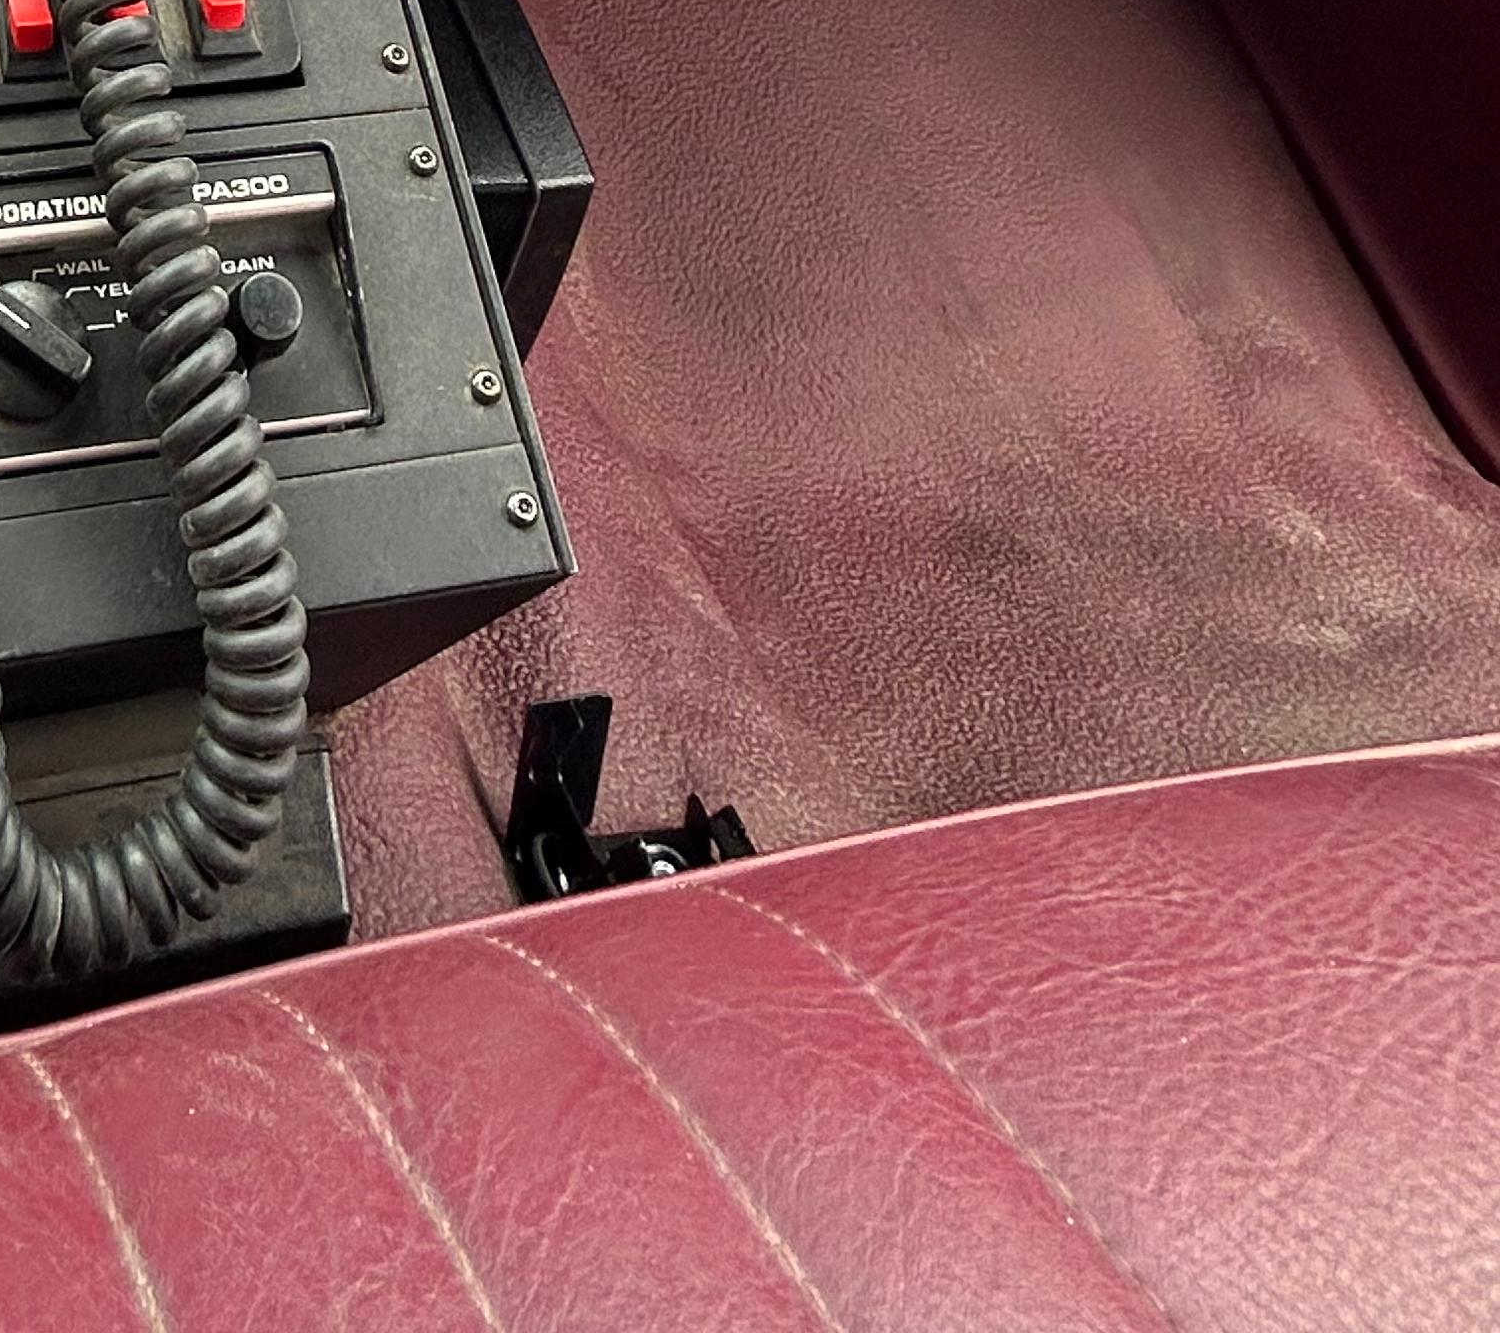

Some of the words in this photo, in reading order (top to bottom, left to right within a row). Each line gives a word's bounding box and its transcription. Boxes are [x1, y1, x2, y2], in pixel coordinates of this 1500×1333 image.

[191, 174, 291, 202] PA300
[55, 259, 111, 276] WAIL
[220, 255, 276, 275] GAIN
[92, 281, 133, 298] YEL
